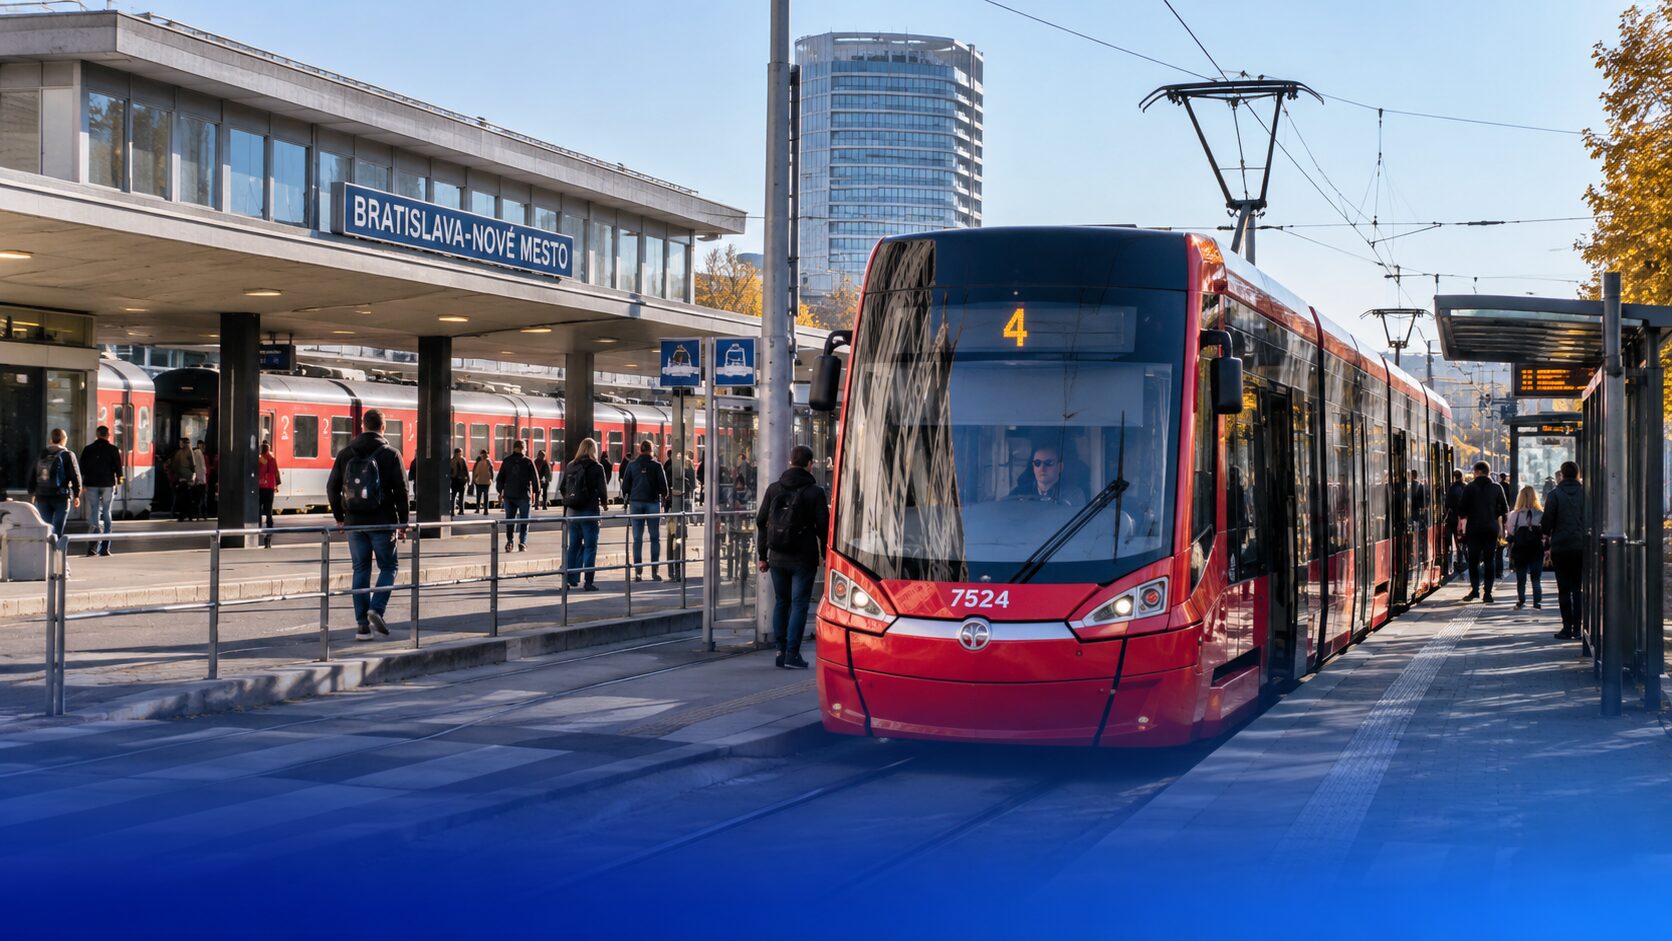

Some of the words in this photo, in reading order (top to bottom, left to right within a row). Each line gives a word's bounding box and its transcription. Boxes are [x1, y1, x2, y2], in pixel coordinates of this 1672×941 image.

[354, 195, 515, 259] BRATISLAVA-NOVÉ
[520, 234, 568, 269] MESTO
[1003, 308, 1028, 347] 4
[951, 589, 1010, 608] 7524
